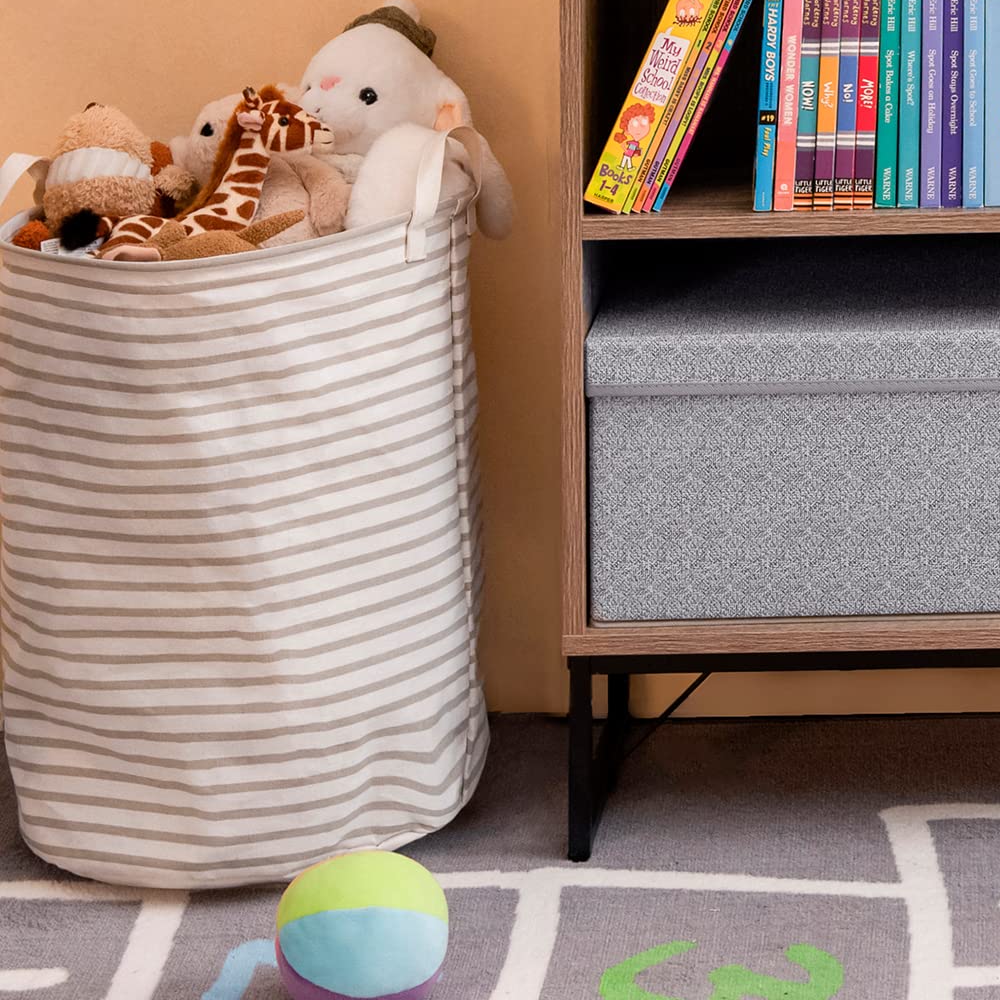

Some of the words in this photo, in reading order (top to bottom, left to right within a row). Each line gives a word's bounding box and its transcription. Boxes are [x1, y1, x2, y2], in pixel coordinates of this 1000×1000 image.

[701, 9, 715, 32] SCHOOL
[711, 11, 724, 34] SCHOOL
[721, 10, 735, 33] SCHOOL
[732, 9, 746, 32] SCHOOL
[766, 7, 779, 49] HARDY
[887, 16, 896, 31] Hill
[908, 17, 916, 32] Hill
[929, 16, 937, 31] Hill
[950, 17, 958, 32] Hill
[970, 16, 978, 31] Hill
[660, 37, 682, 57] My
[705, 40, 712, 49] 2
[649, 49, 682, 75] Weird
[765, 50, 777, 81] BOYS
[786, 35, 797, 80] WONDER
[884, 49, 894, 68] Spot
[907, 50, 916, 82] Where's
[927, 49, 937, 67] Spot
[949, 50, 959, 68] Spot
[968, 49, 978, 67] Spot
[641, 67, 674, 91] School
[885, 70, 894, 94] Bakes
[928, 69, 936, 88] Goes
[949, 70, 959, 93] Stays
[969, 69, 977, 88] Goes
[634, 82, 667, 104] Collection
[784, 84, 795, 125] WOMEN
[802, 80, 815, 111] NOW!
[820, 81, 834, 109] Why?
[842, 83, 854, 103] No!
[860, 78, 875, 109] MORE!
[905, 83, 915, 106] Spot?
[928, 90, 934, 100] on
[884, 103, 893, 123] Cake
[926, 103, 936, 134] Holiday
[947, 95, 958, 135] Overnight
[968, 100, 977, 127] School
[599, 163, 633, 185] Books
[637, 158, 651, 182] GUTMAN
[645, 160, 660, 184] GUTMAN
[656, 158, 670, 182] GUTMAN
[835, 184, 853, 192] TIGER
[855, 183, 872, 192] TIGER
[882, 167, 891, 201] WARNE
[904, 167, 914, 201] WARNE
[926, 166, 936, 200] WARNE
[948, 166, 957, 200] WARNE
[968, 166, 977, 200] WARNE
